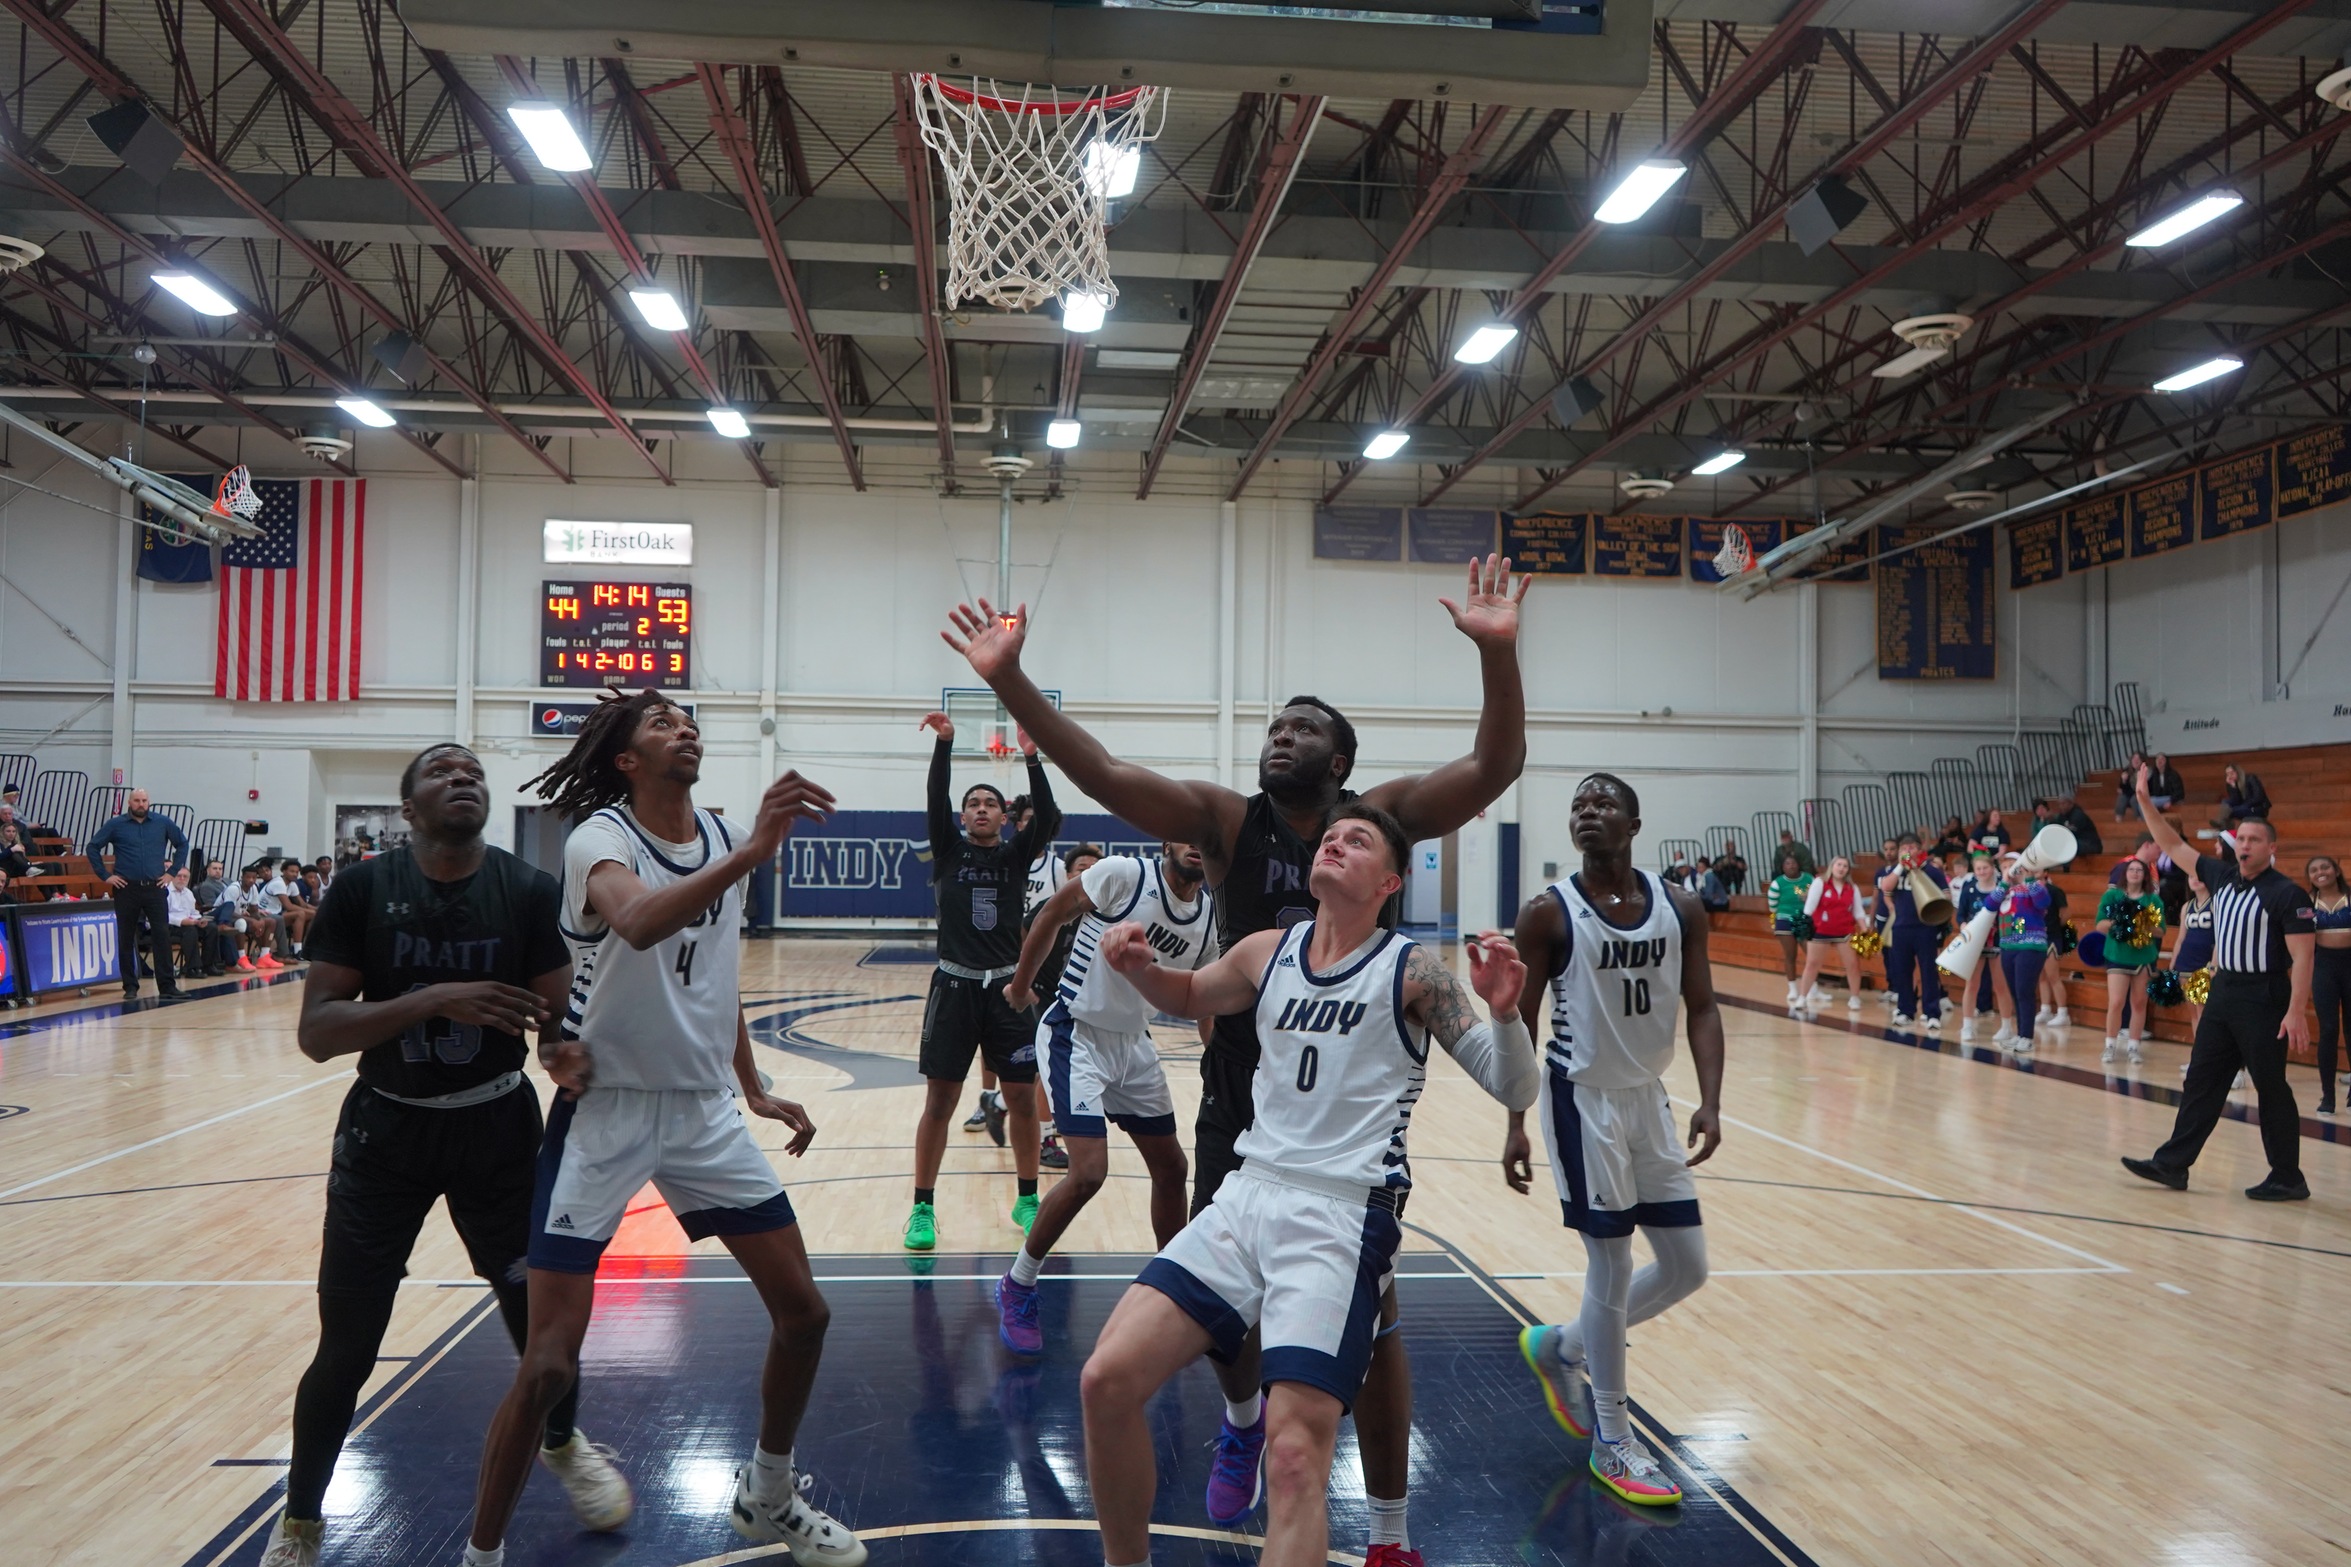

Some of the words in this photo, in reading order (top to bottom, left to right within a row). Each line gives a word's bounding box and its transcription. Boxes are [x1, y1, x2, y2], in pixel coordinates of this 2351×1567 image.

[2217, 502, 2259, 525] CHAMPIONS
[591, 530, 675, 550] FirstOak
[1597, 540, 1626, 551] VALLEY
[1629, 541, 1639, 552] OF
[1645, 542, 1660, 553] THE
[549, 584, 574, 595] Home
[655, 586, 686, 598] Guests
[549, 598, 579, 619] 44
[658, 600, 687, 622] 53
[602, 621, 629, 633] period
[637, 617, 650, 635] 2
[546, 637, 567, 647] fouls
[601, 637, 630, 649] player
[663, 639, 684, 650] fouls
[558, 653, 566, 668] 1
[576, 653, 588, 668] 4
[641, 654, 653, 671] 6
[670, 654, 682, 671] 3
[1920, 667, 1956, 678] PIRATES
[563, 714, 589, 724] pep
[2333, 704, 2351, 717] Ha
[2183, 716, 2220, 731] Attitude
[789, 837, 908, 889] INDY
[1264, 857, 1311, 894] PRA
[1026, 880, 1045, 893] DY
[972, 888, 998, 931] 5
[1145, 922, 1190, 960] INDY
[51, 922, 115, 984] INDY
[393, 931, 501, 973] PRATT
[1596, 937, 1667, 970] INDY
[675, 941, 697, 986] 4
[1622, 978, 1652, 1017] 10
[1273, 998, 1368, 1035] INDY
[1296, 1045, 1318, 1093] 0
